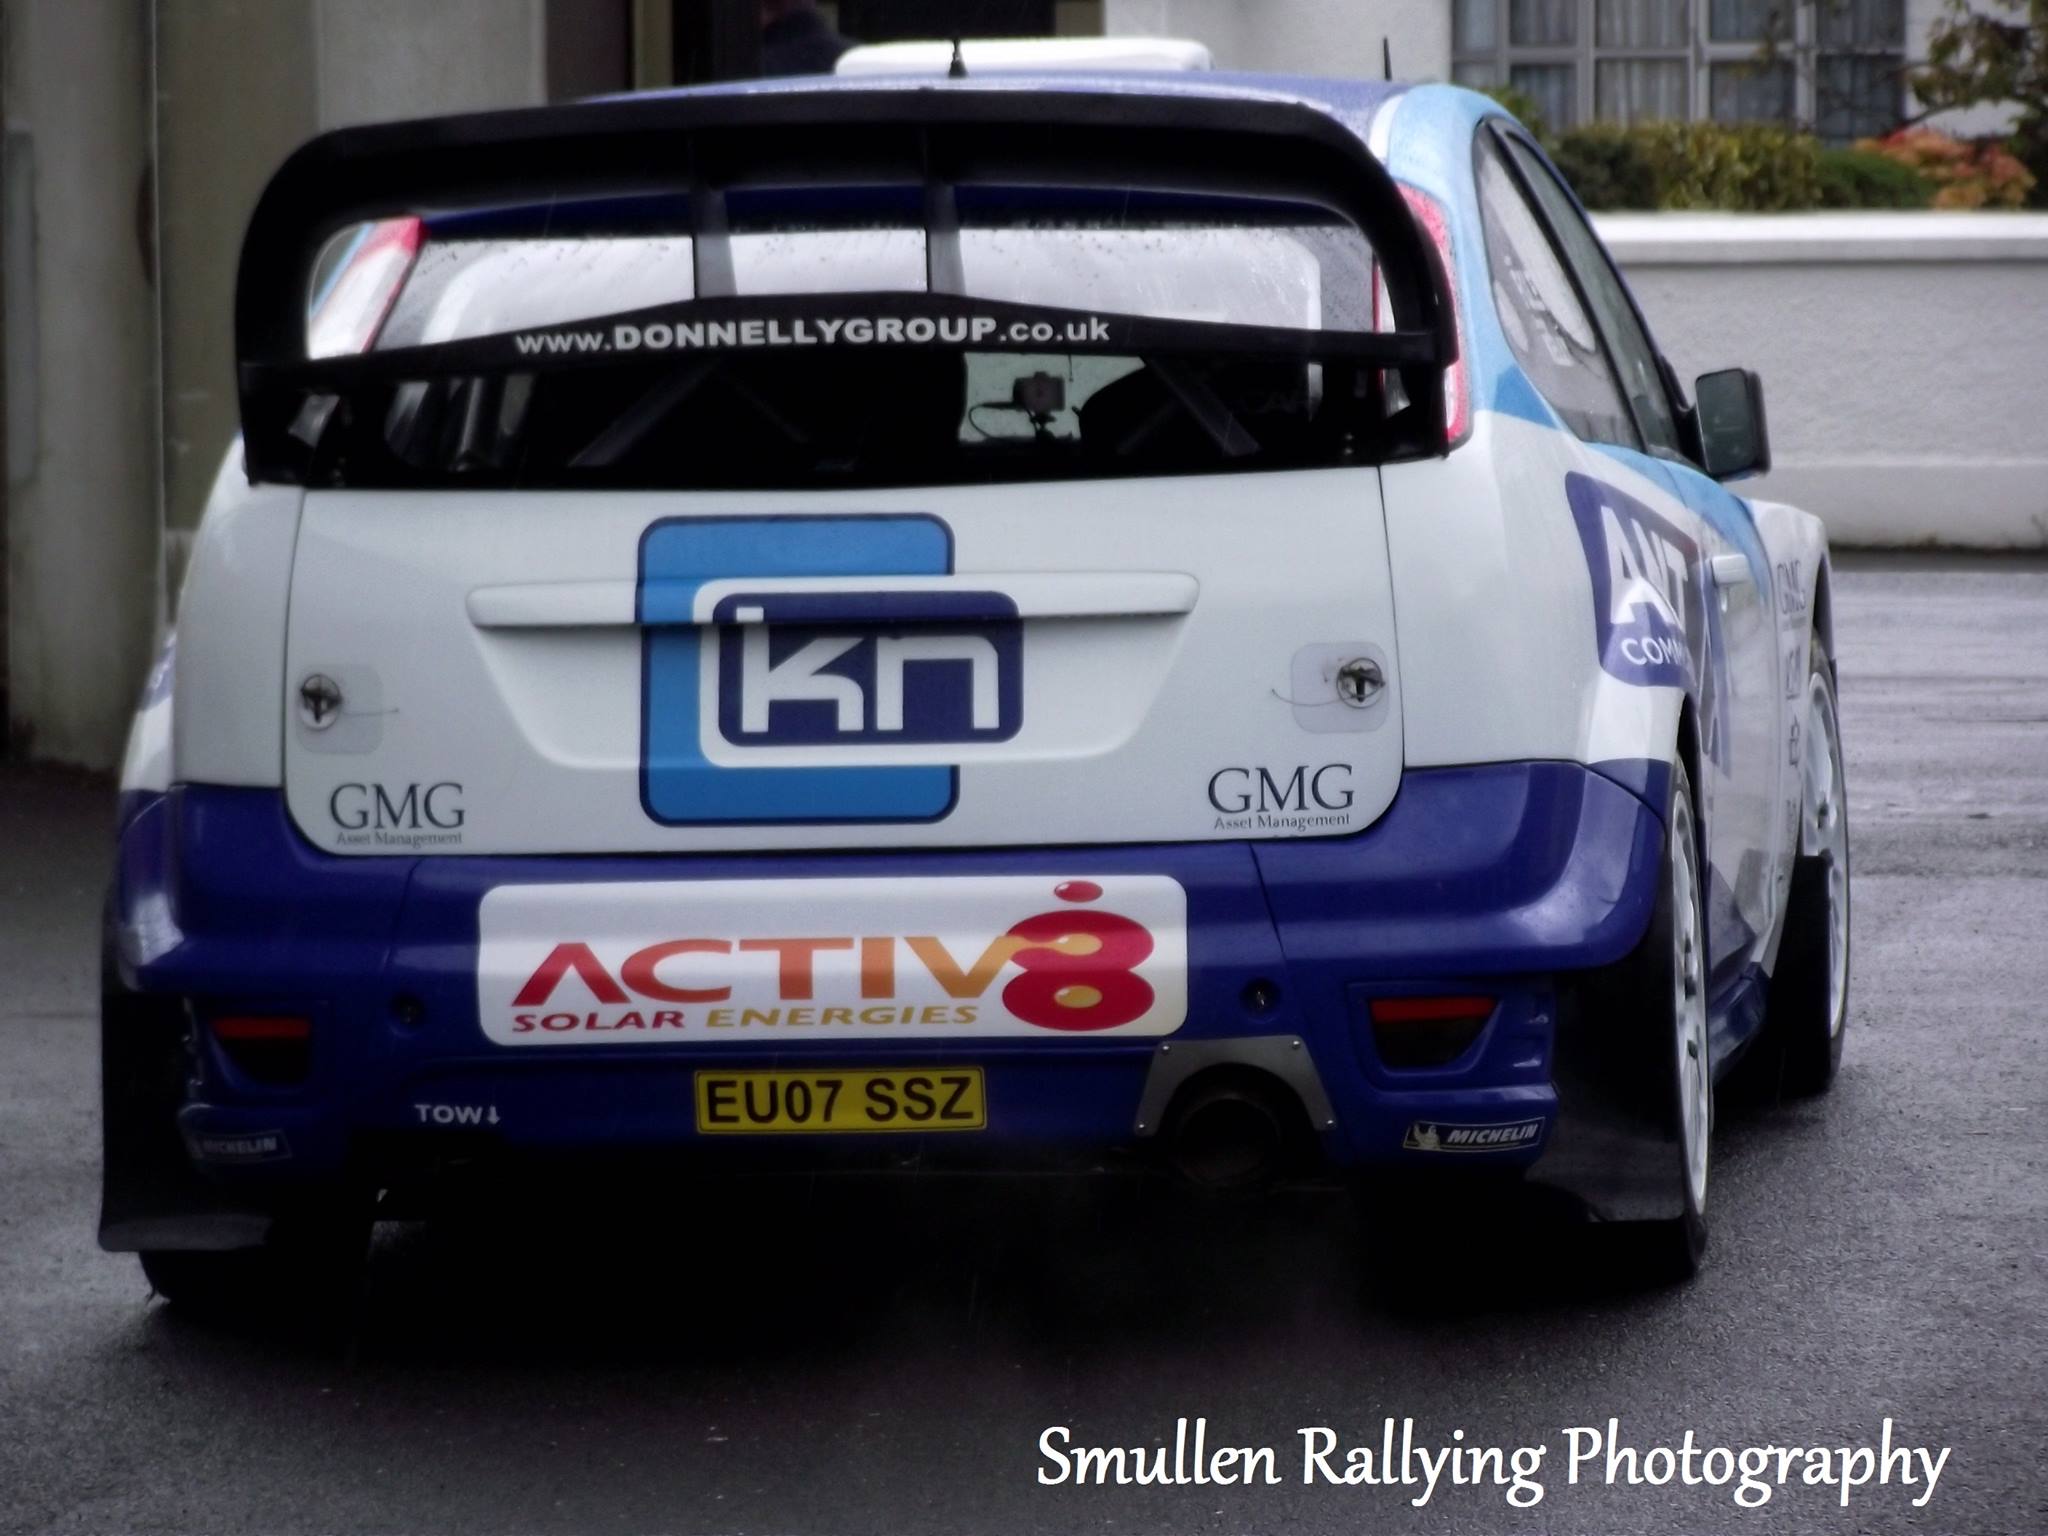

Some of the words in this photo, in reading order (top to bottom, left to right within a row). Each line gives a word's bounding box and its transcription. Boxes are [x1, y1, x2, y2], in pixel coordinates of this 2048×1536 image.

[515, 317, 1110, 354] www.DONNELLYGROUP.co.uk
[1208, 764, 1354, 814] GMG
[330, 782, 465, 830] GMG
[1214, 815, 1251, 830] Asset
[1257, 813, 1350, 832] Management
[336, 832, 371, 846] Asset
[375, 831, 463, 849] Management
[511, 908, 1156, 1032] ACTIV8
[511, 1010, 685, 1033] SOLAR
[706, 1005, 978, 1029] ENERGIES
[414, 1104, 483, 1124] TOW
[706, 1079, 843, 1124] EU07
[864, 1076, 974, 1122] SSZ
[1447, 1123, 1539, 1144] MICHELIN
